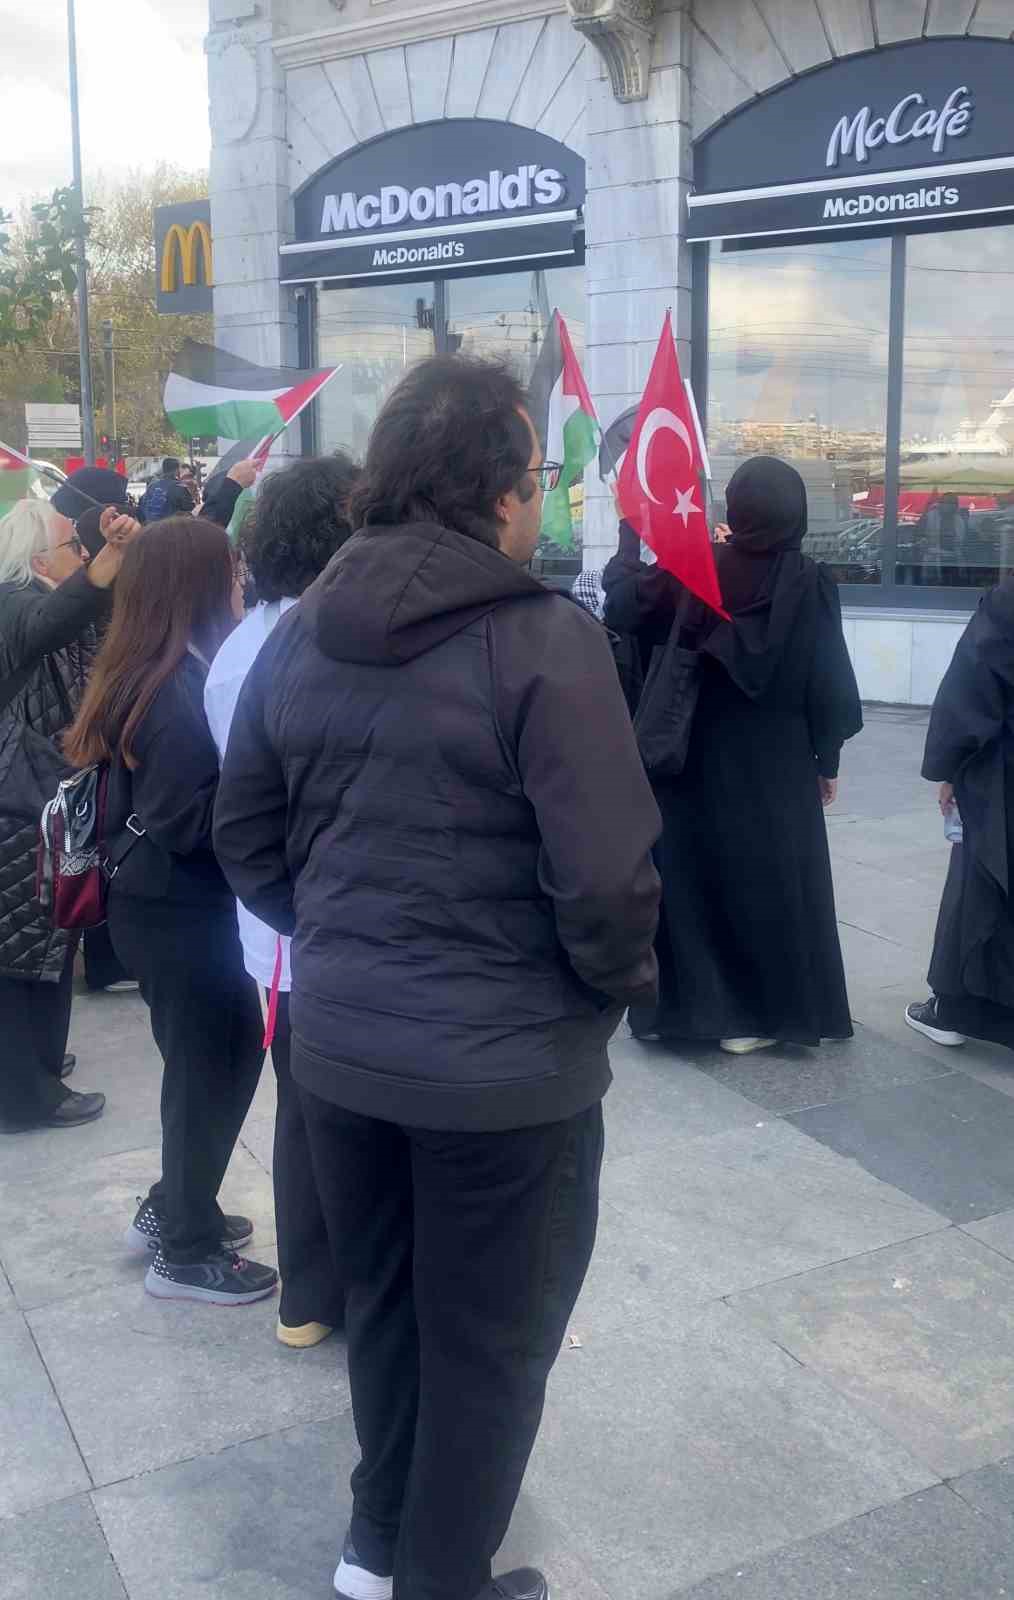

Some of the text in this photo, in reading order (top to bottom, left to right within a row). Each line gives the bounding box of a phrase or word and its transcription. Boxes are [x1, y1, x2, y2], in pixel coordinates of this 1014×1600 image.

[826, 86, 971, 167] McCafé
[320, 164, 564, 233] McDonald's
[823, 186, 960, 218] McDonald's
[372, 241, 465, 266] McDonald's
